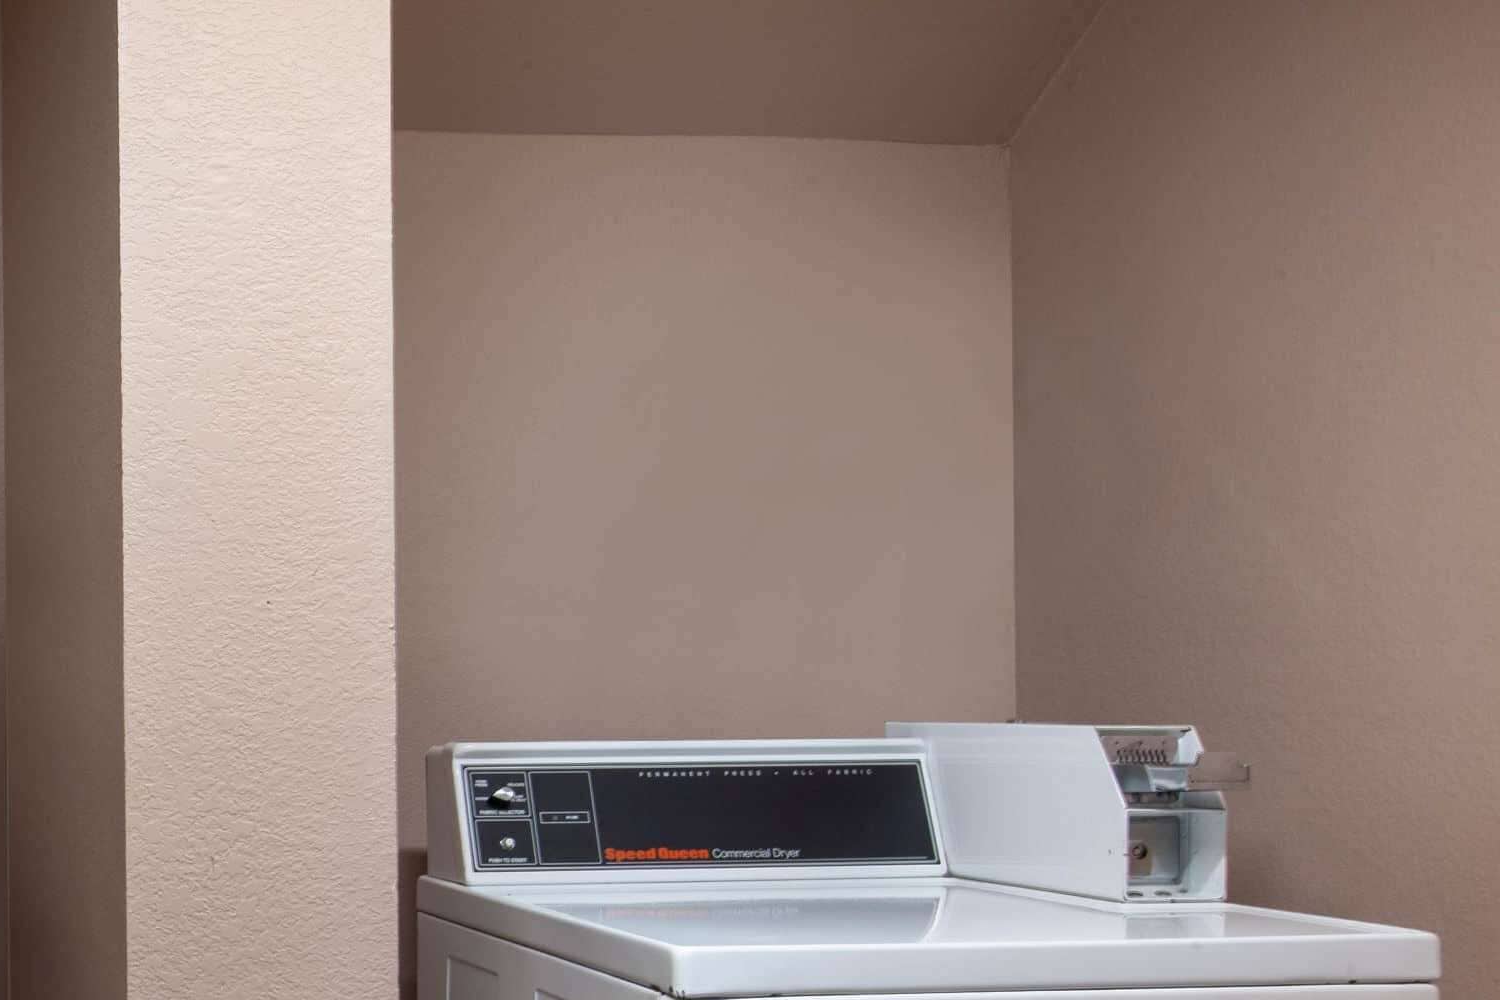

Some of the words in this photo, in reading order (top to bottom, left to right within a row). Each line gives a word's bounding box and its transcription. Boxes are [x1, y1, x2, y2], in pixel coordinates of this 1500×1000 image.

[638, 769, 710, 778] PERMANENT
[827, 768, 873, 776] FABRIC
[605, 848, 656, 862] Speed
[659, 847, 709, 859] Queen
[712, 848, 771, 858] Commercial
[773, 848, 801, 860] Dryer
